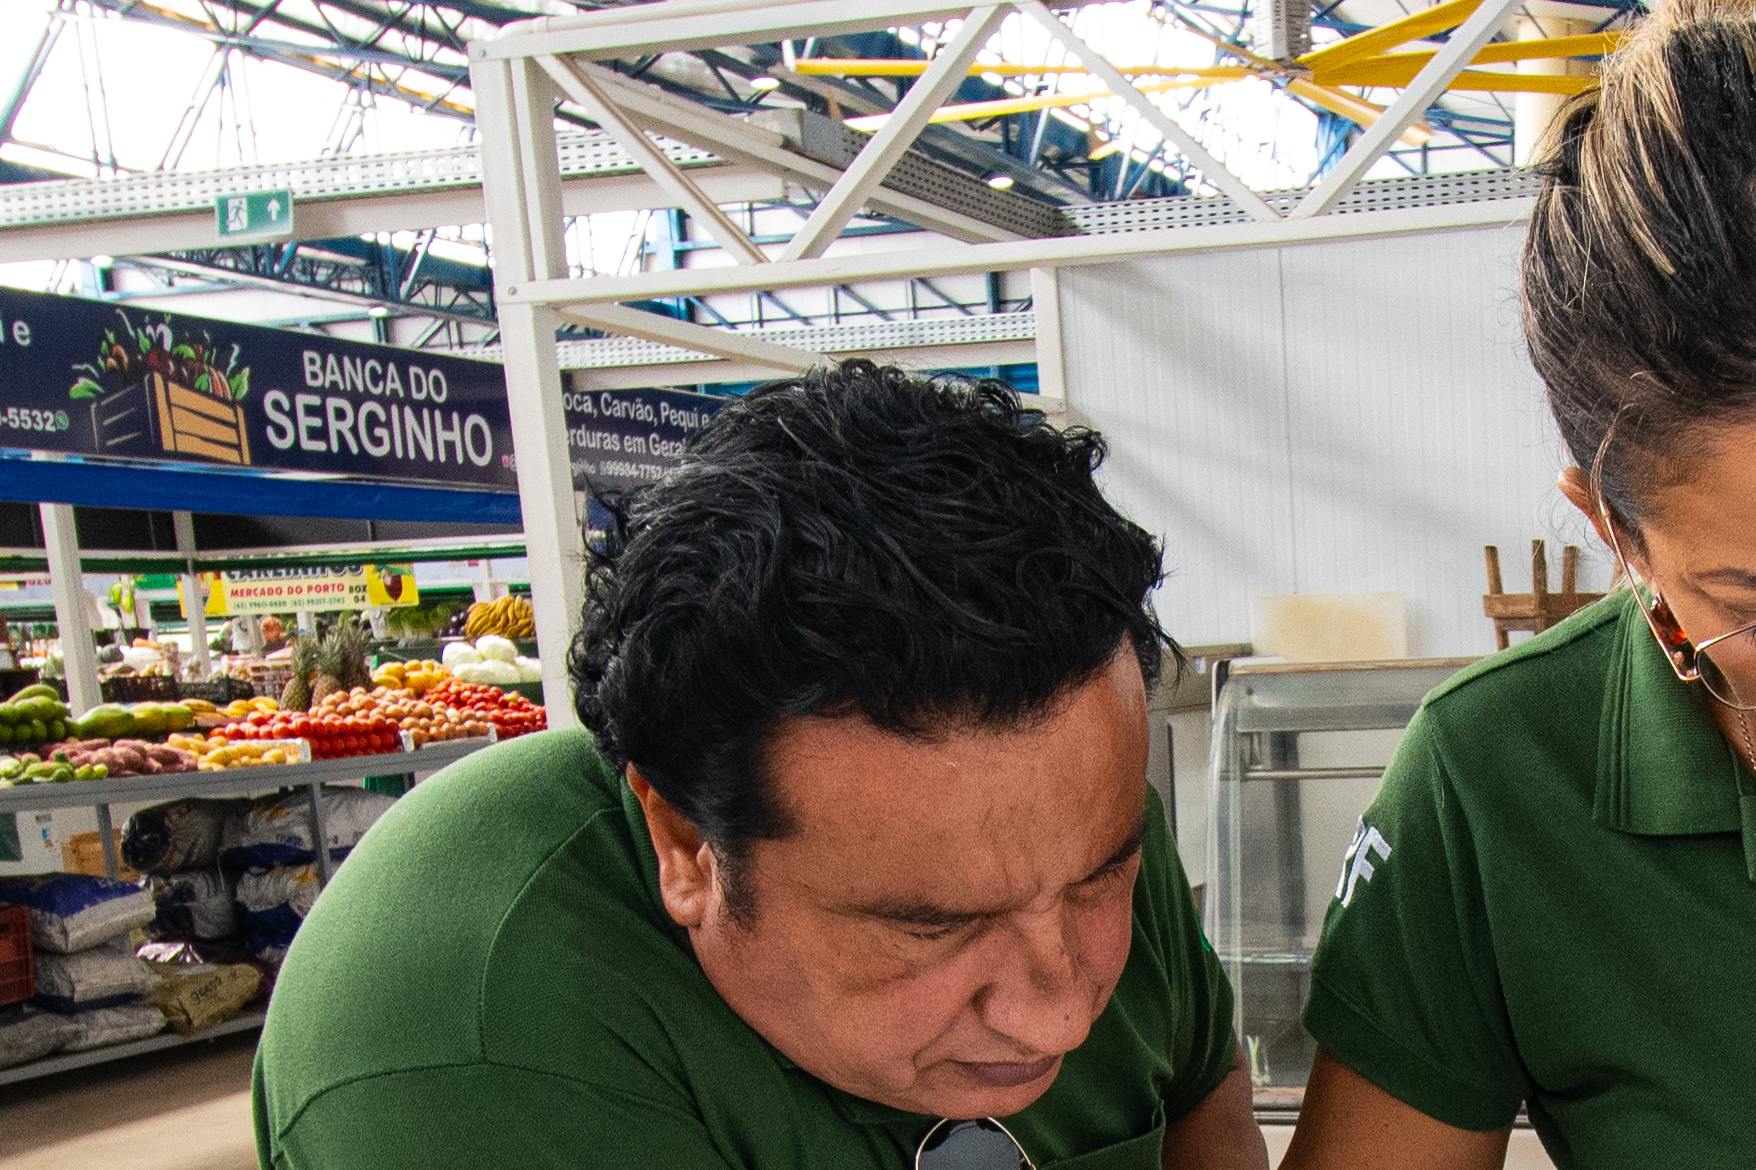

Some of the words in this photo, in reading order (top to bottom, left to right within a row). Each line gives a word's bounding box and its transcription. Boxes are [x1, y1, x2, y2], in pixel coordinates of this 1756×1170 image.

[303, 350, 404, 398] BANCA
[408, 365, 447, 403] DO
[562, 392, 598, 418] oca,
[601, 392, 658, 427] Carvão,
[660, 401, 699, 432] Pequi
[263, 389, 492, 467] SERGINHO
[567, 424, 620, 452] rduras
[623, 435, 646, 455] em
[230, 586, 283, 598] MERCADO
[287, 584, 303, 595] DO
[306, 582, 345, 594] PORTO
[348, 584, 368, 594] BOX
[353, 595, 366, 603] 04
